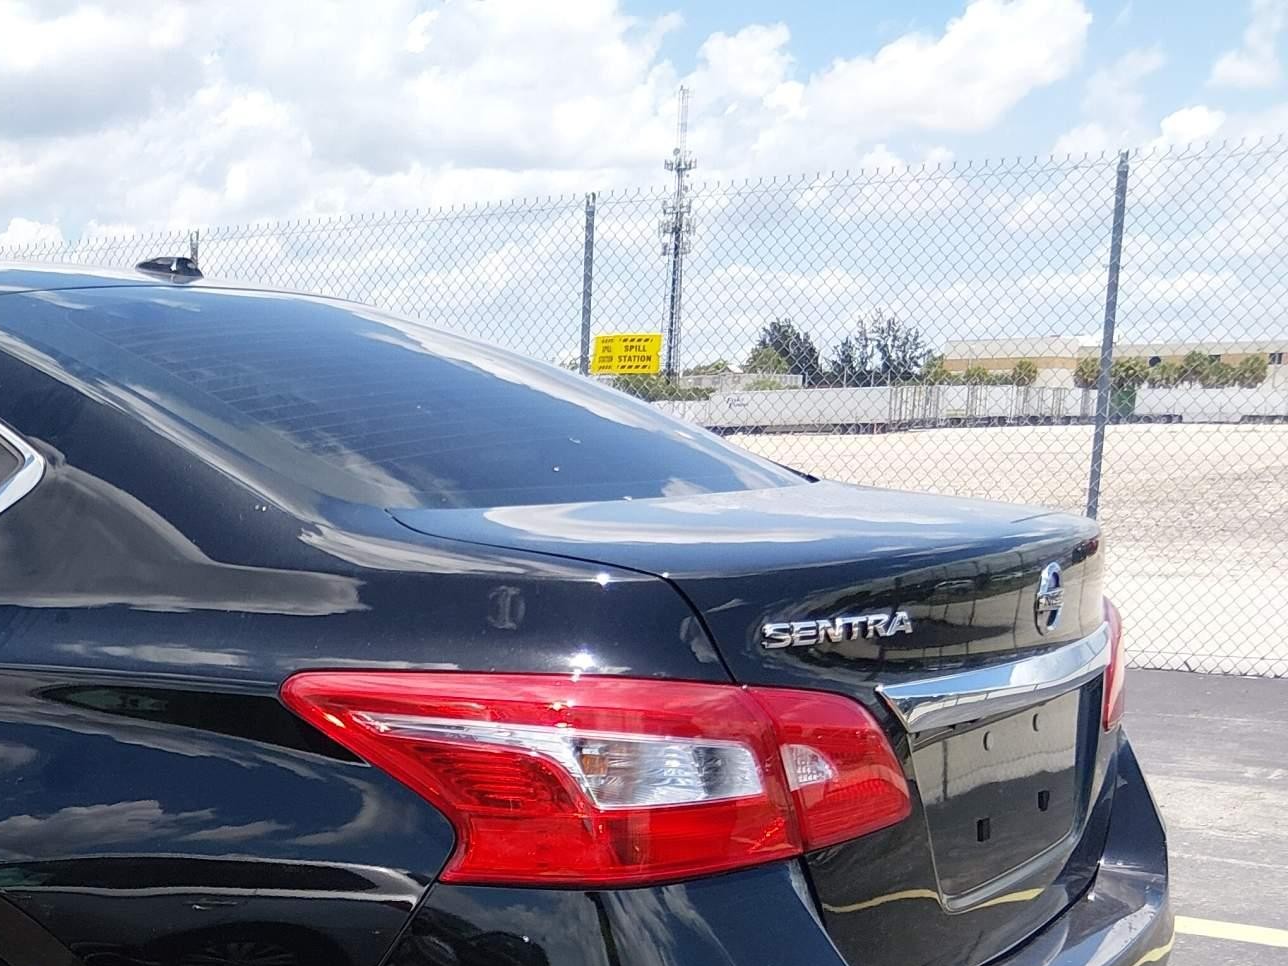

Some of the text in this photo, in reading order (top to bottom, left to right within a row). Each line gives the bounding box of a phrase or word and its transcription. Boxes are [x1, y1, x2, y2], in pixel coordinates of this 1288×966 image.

[624, 344, 647, 353] SPILL
[617, 354, 652, 363] STATION
[761, 611, 914, 649] SENTRA
